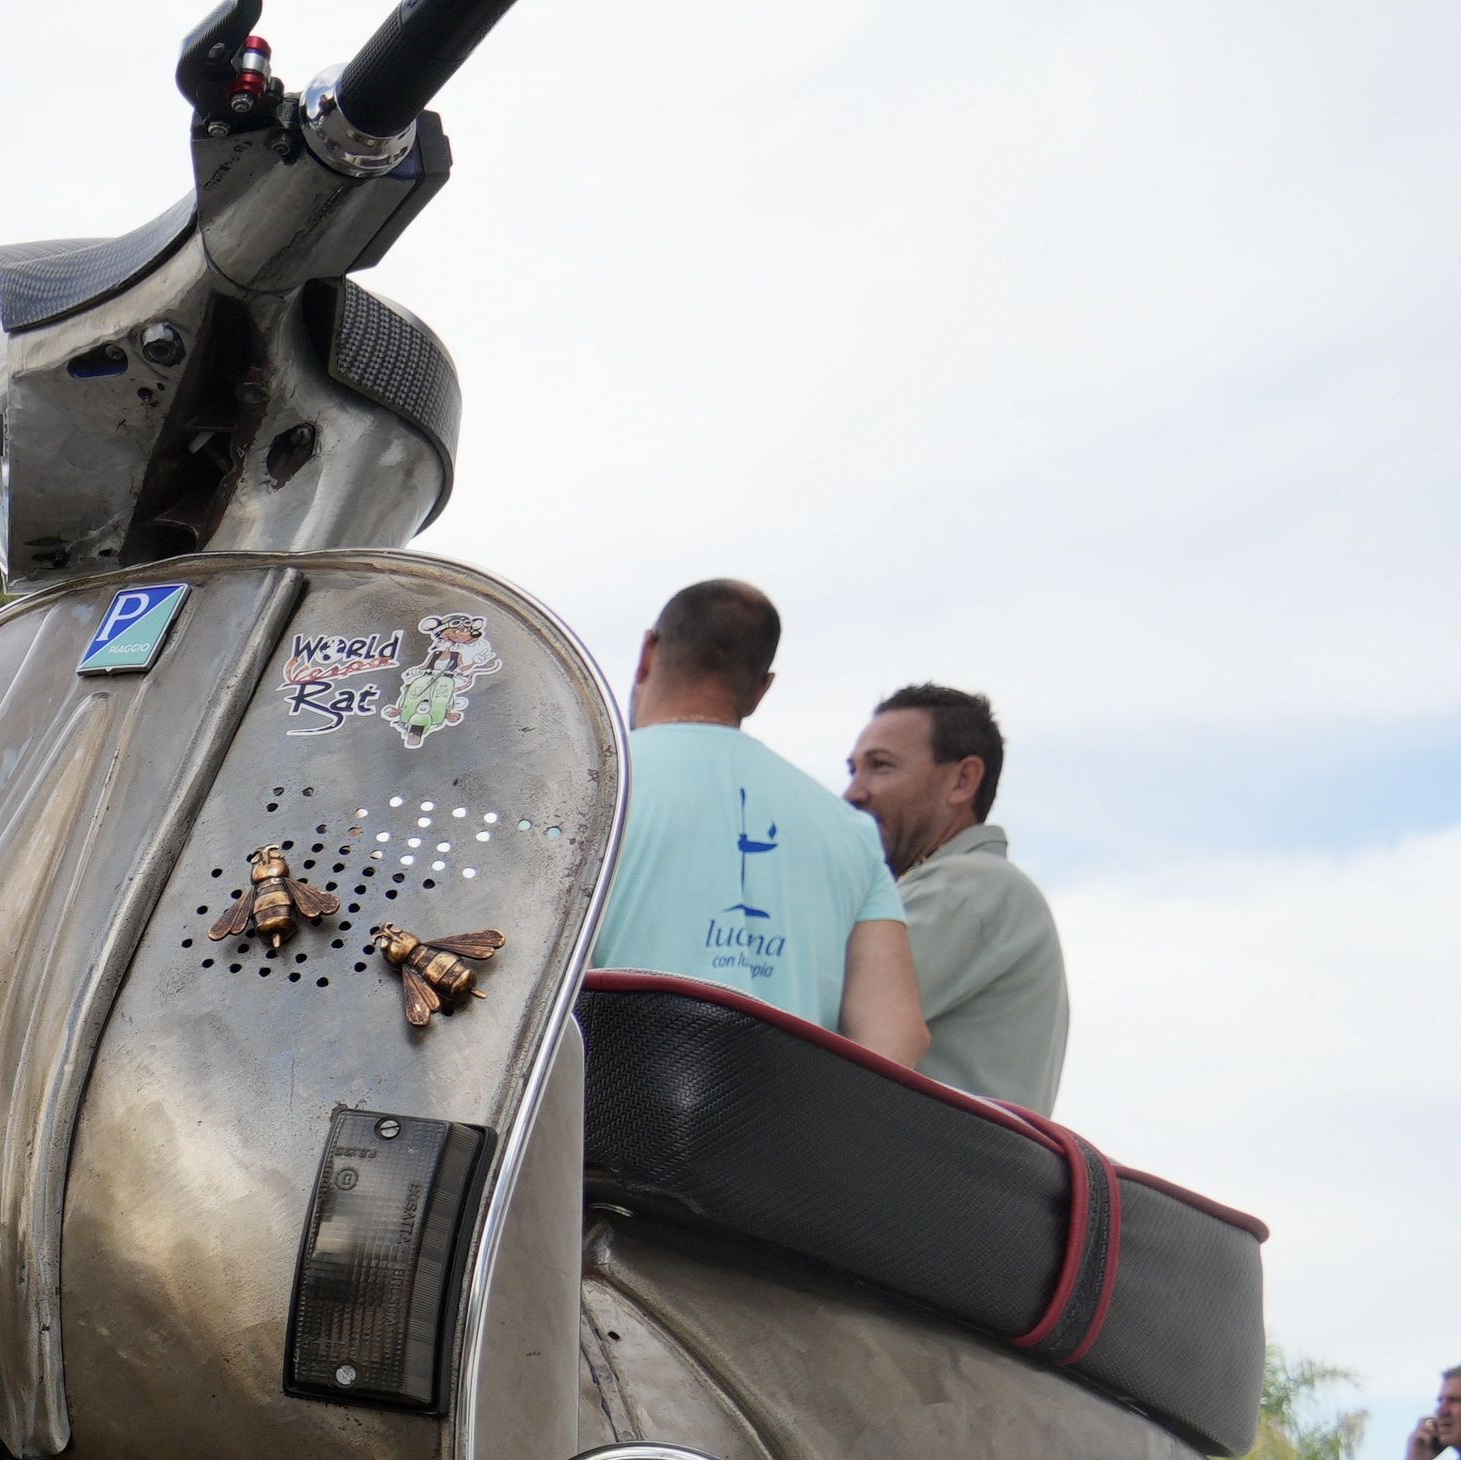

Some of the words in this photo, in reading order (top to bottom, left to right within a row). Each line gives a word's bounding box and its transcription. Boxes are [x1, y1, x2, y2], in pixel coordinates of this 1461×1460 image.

[96, 593, 150, 642] P
[107, 642, 151, 654] PIAGGIO
[288, 681, 379, 734] Rat
